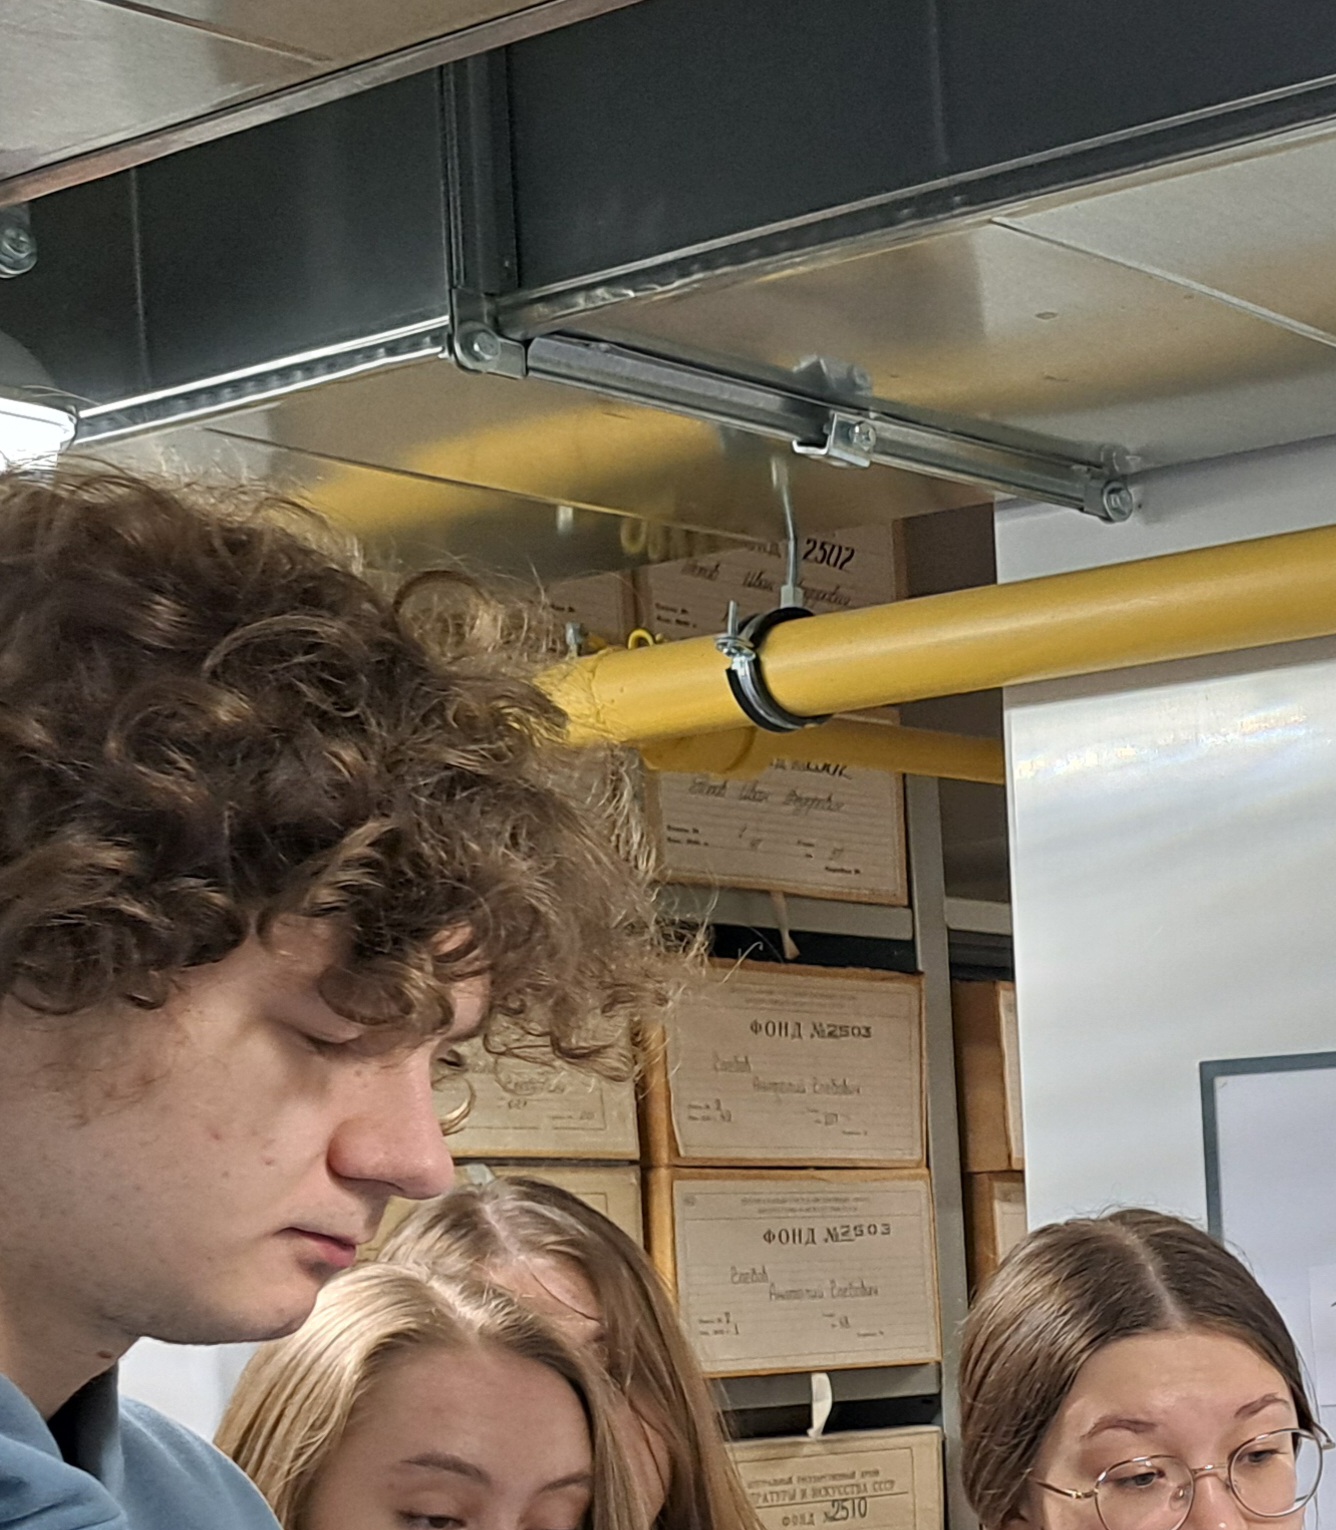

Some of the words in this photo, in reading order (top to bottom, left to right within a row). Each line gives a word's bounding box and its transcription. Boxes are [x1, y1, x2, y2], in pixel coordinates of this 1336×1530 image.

[801, 538, 856, 571] 2502
[750, 1018, 803, 1040] ФОНД
[763, 1228, 817, 1246] ФОНД
